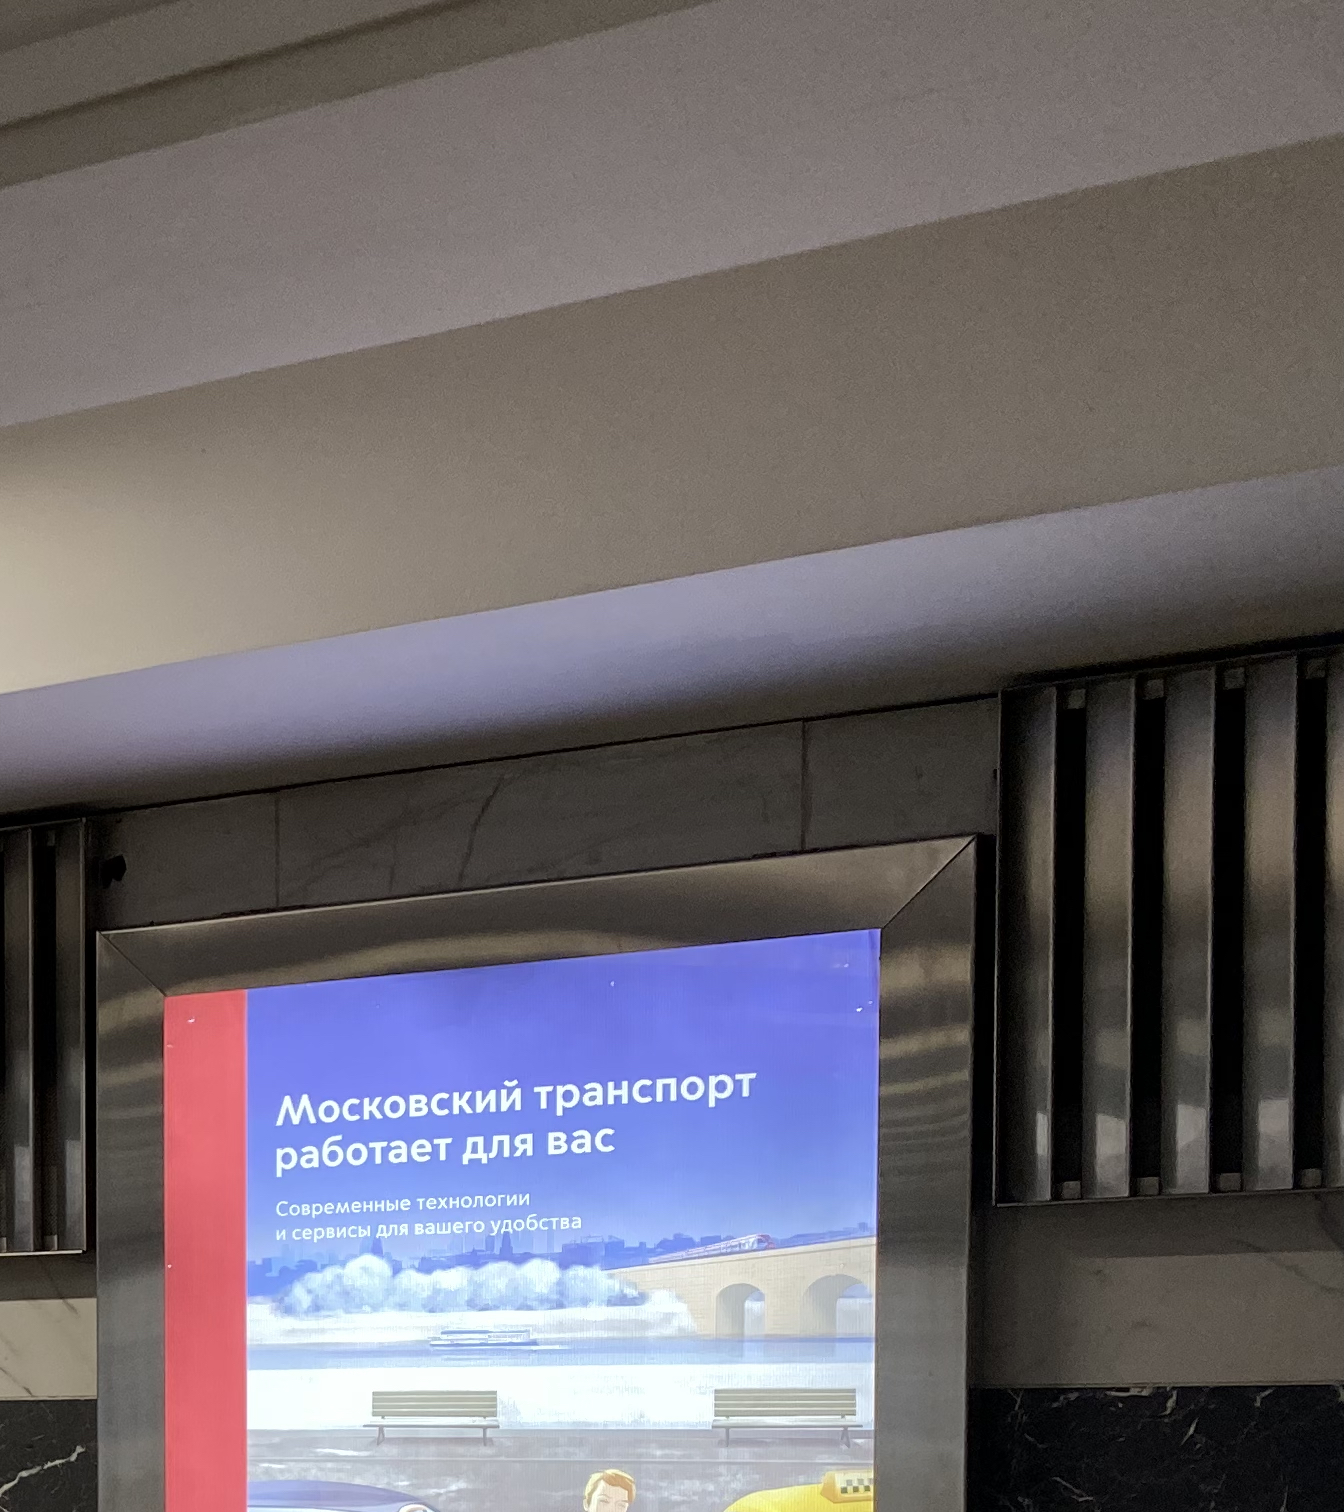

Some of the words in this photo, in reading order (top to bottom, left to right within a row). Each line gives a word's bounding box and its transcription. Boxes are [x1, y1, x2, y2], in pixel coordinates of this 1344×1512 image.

[275, 1079, 522, 1127] Московский
[533, 1072, 757, 1117] транспорт
[275, 1135, 453, 1177] работает
[462, 1133, 534, 1165] для
[547, 1128, 615, 1155] вас
[276, 1198, 411, 1219] Современные
[417, 1193, 530, 1211] технологии
[275, 1229, 286, 1241] и
[292, 1224, 371, 1243] сервисы
[375, 1222, 409, 1239] для
[414, 1219, 485, 1236] вашего
[490, 1214, 582, 1236] удобства
